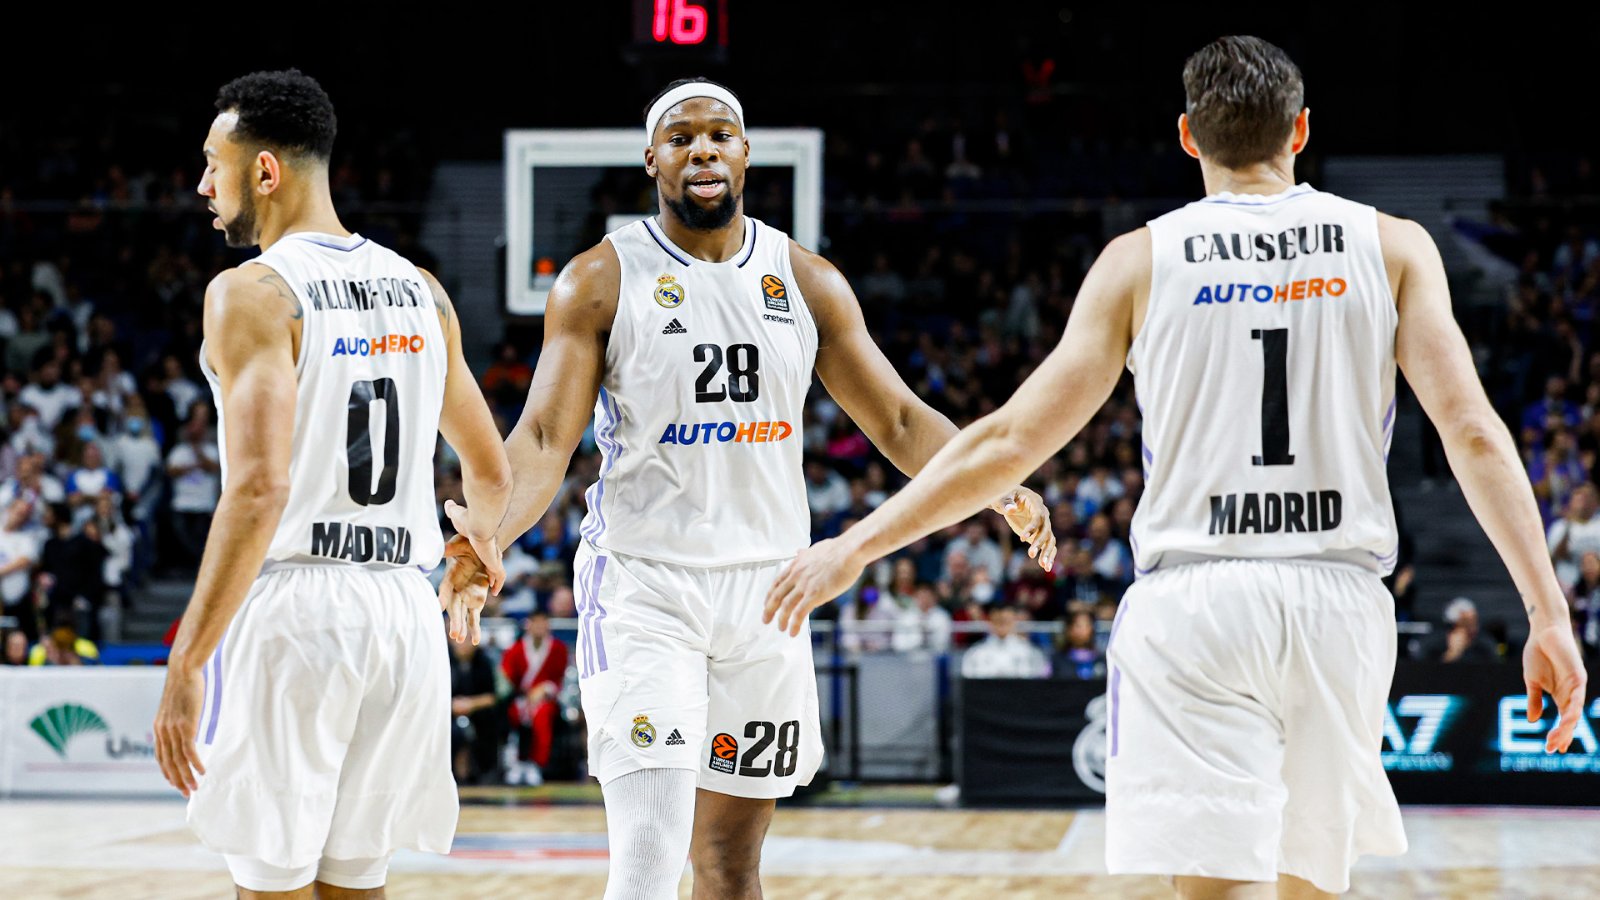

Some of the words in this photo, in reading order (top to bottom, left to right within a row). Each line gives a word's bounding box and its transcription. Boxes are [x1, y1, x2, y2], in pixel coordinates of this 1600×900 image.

[652, 0, 708, 45] 16
[1184, 224, 1344, 263] CAUSEUR
[1193, 278, 1347, 305] AUTOHERO
[331, 333, 425, 357] AUOHERO
[662, 327, 687, 335] adidas
[693, 343, 759, 403] 28
[1251, 328, 1295, 466] 1
[346, 377, 400, 507] 0
[1209, 489, 1343, 535] MADRID
[311, 522, 412, 565] MADRID
[665, 738, 686, 746] adidas
[1498, 694, 1600, 754] EA
[738, 720, 800, 777] 28
